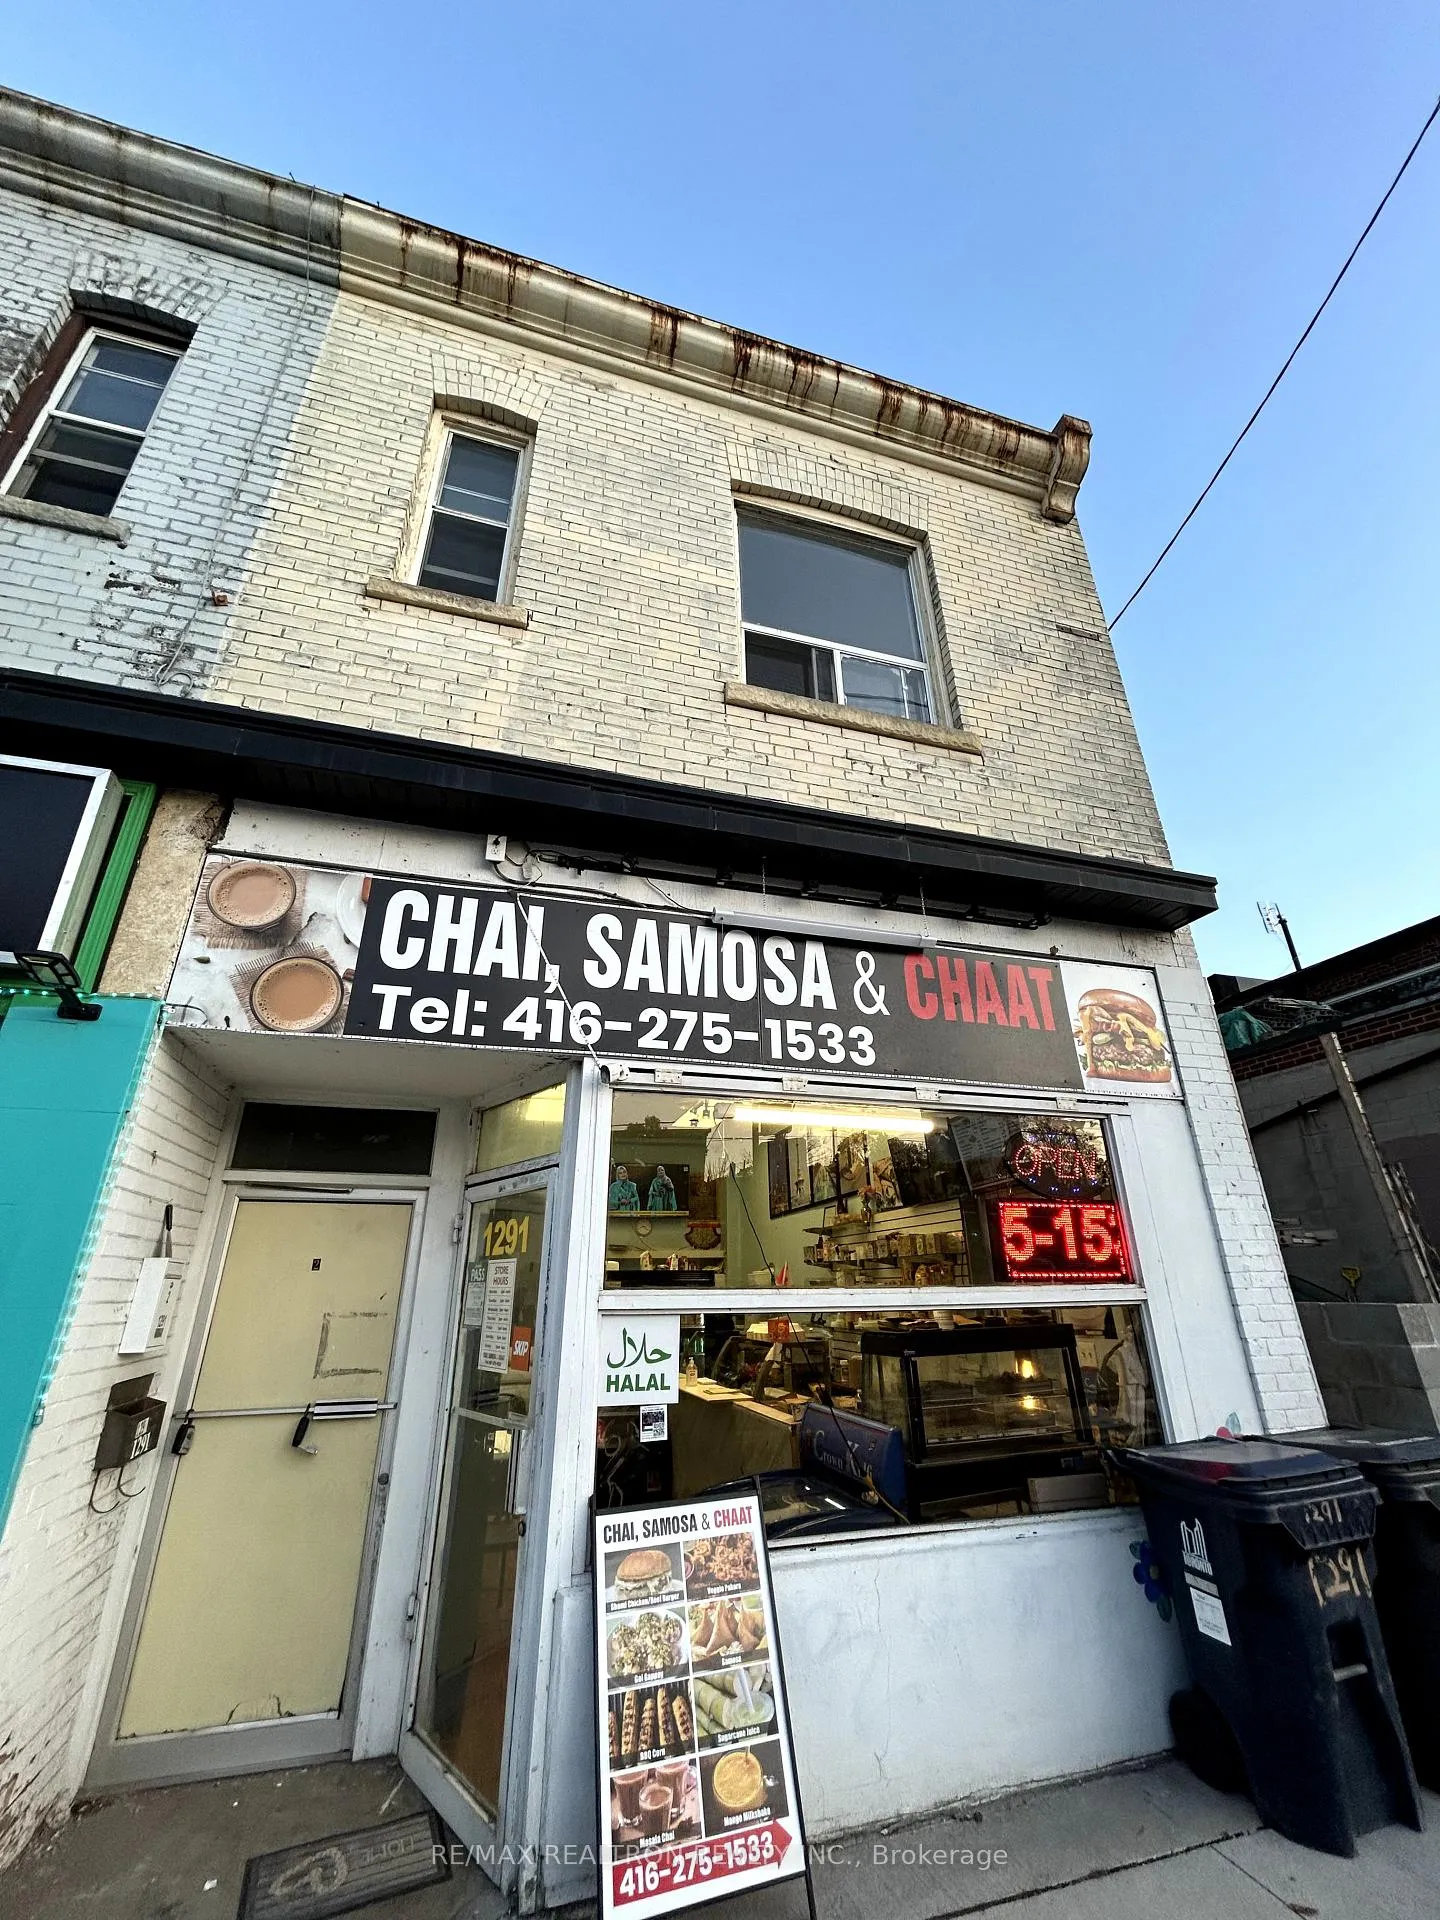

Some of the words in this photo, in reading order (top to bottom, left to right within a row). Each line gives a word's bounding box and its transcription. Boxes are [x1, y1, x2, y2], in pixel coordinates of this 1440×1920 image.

[379, 889, 561, 993] CHAI,
[583, 912, 836, 1011] SAMOSA
[853, 950, 890, 1016] &
[903, 953, 1056, 1032] CHAAT
[371, 984, 488, 1038] Tel:
[502, 997, 876, 1067] 416-275-1533
[1015, 1144, 1098, 1180] OPEN
[484, 1216, 530, 1256] 1291
[470, 1268, 486, 1282] PASS
[513, 1340, 529, 1357] SKIP
[606, 1327, 672, 1369] حلال
[606, 1373, 671, 1393] HALAL
[603, 1521, 639, 1544] CHAI,
[642, 1513, 698, 1539] SAMOSA
[701, 1513, 711, 1530] &
[713, 1506, 753, 1528] CHAAT
[1307, 1547, 1372, 1609] 1291
[652, 1748, 666, 1758] Corn
[661, 1829, 675, 1843] Chai
[619, 1829, 774, 1897] 416-275-1533
